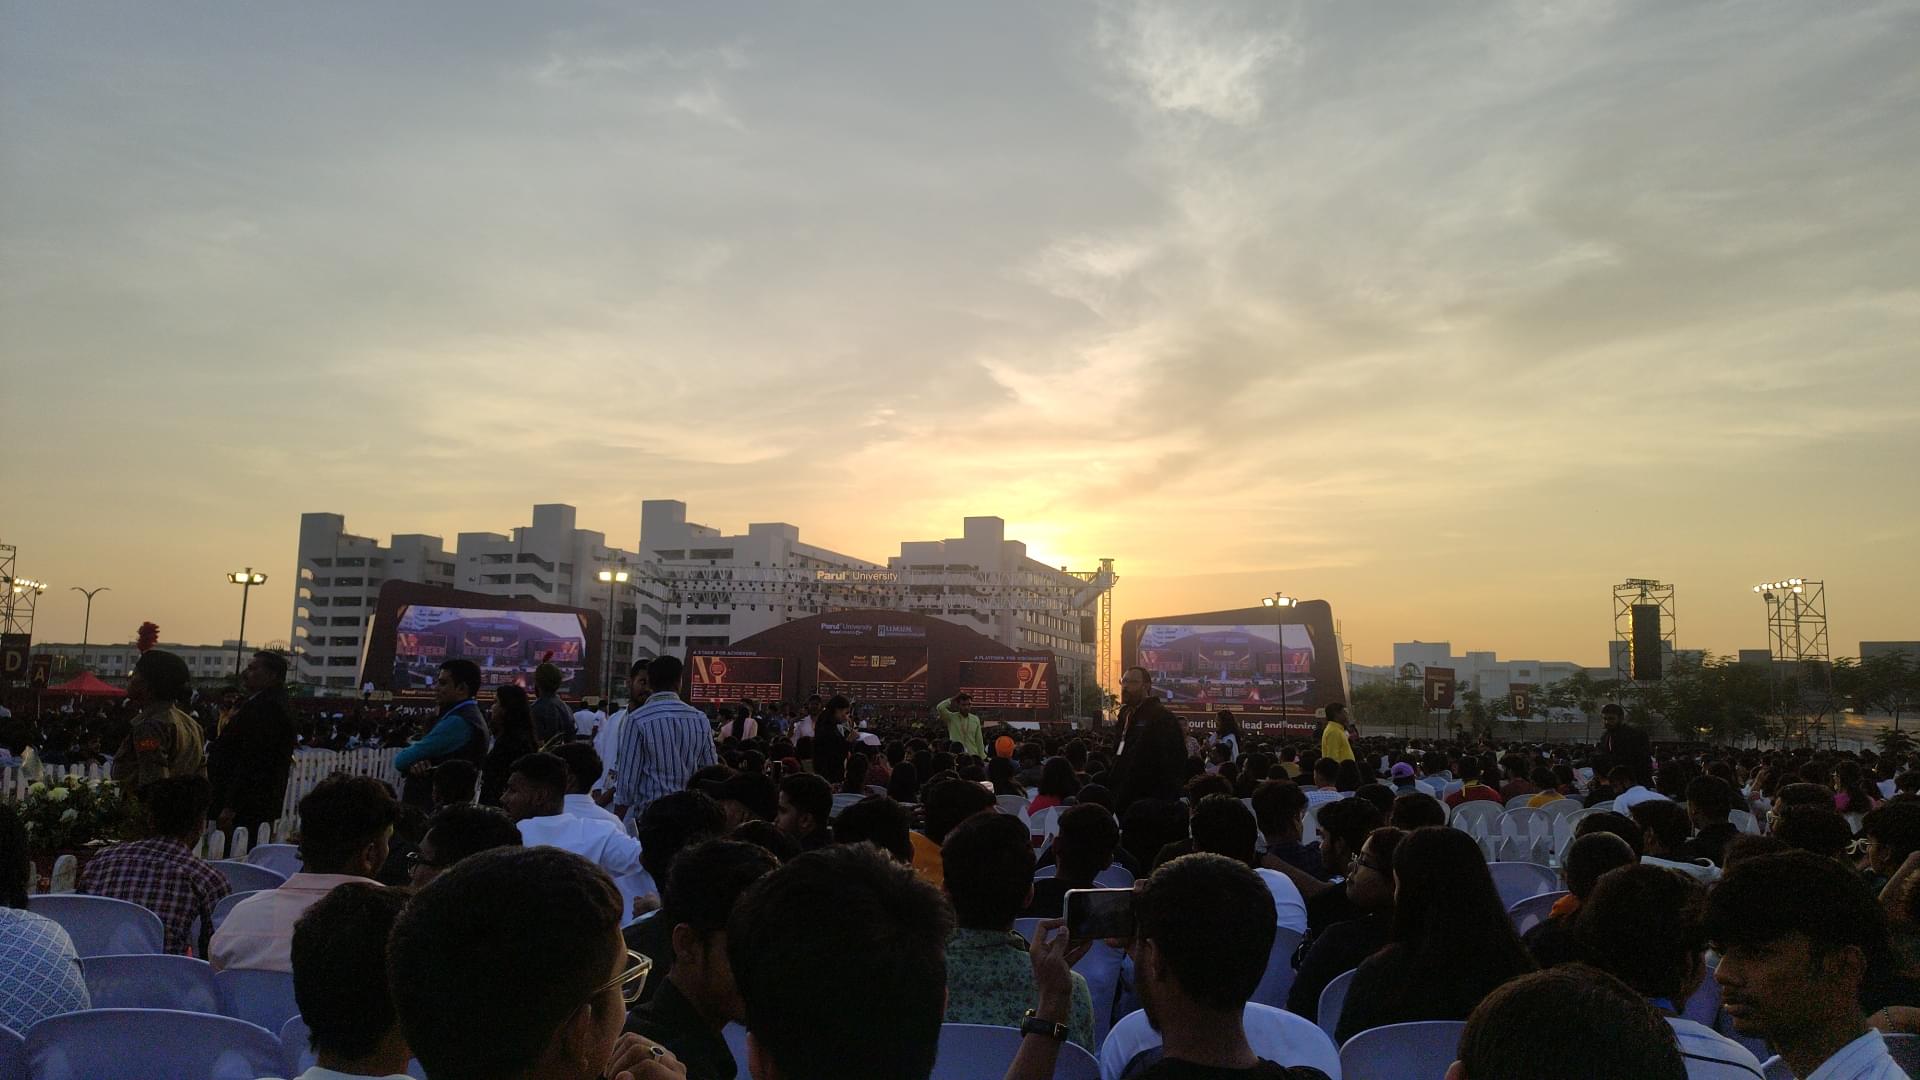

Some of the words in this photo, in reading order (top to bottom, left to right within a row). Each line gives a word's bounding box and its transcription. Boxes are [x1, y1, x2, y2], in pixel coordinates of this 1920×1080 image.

[817, 570, 846, 580] Parul
[852, 571, 898, 583] University
[5, 650, 22, 671] D
[34, 666, 45, 683] A
[1433, 682, 1446, 701] F
[1515, 695, 1525, 710] B
[1242, 719, 1263, 730] lead
